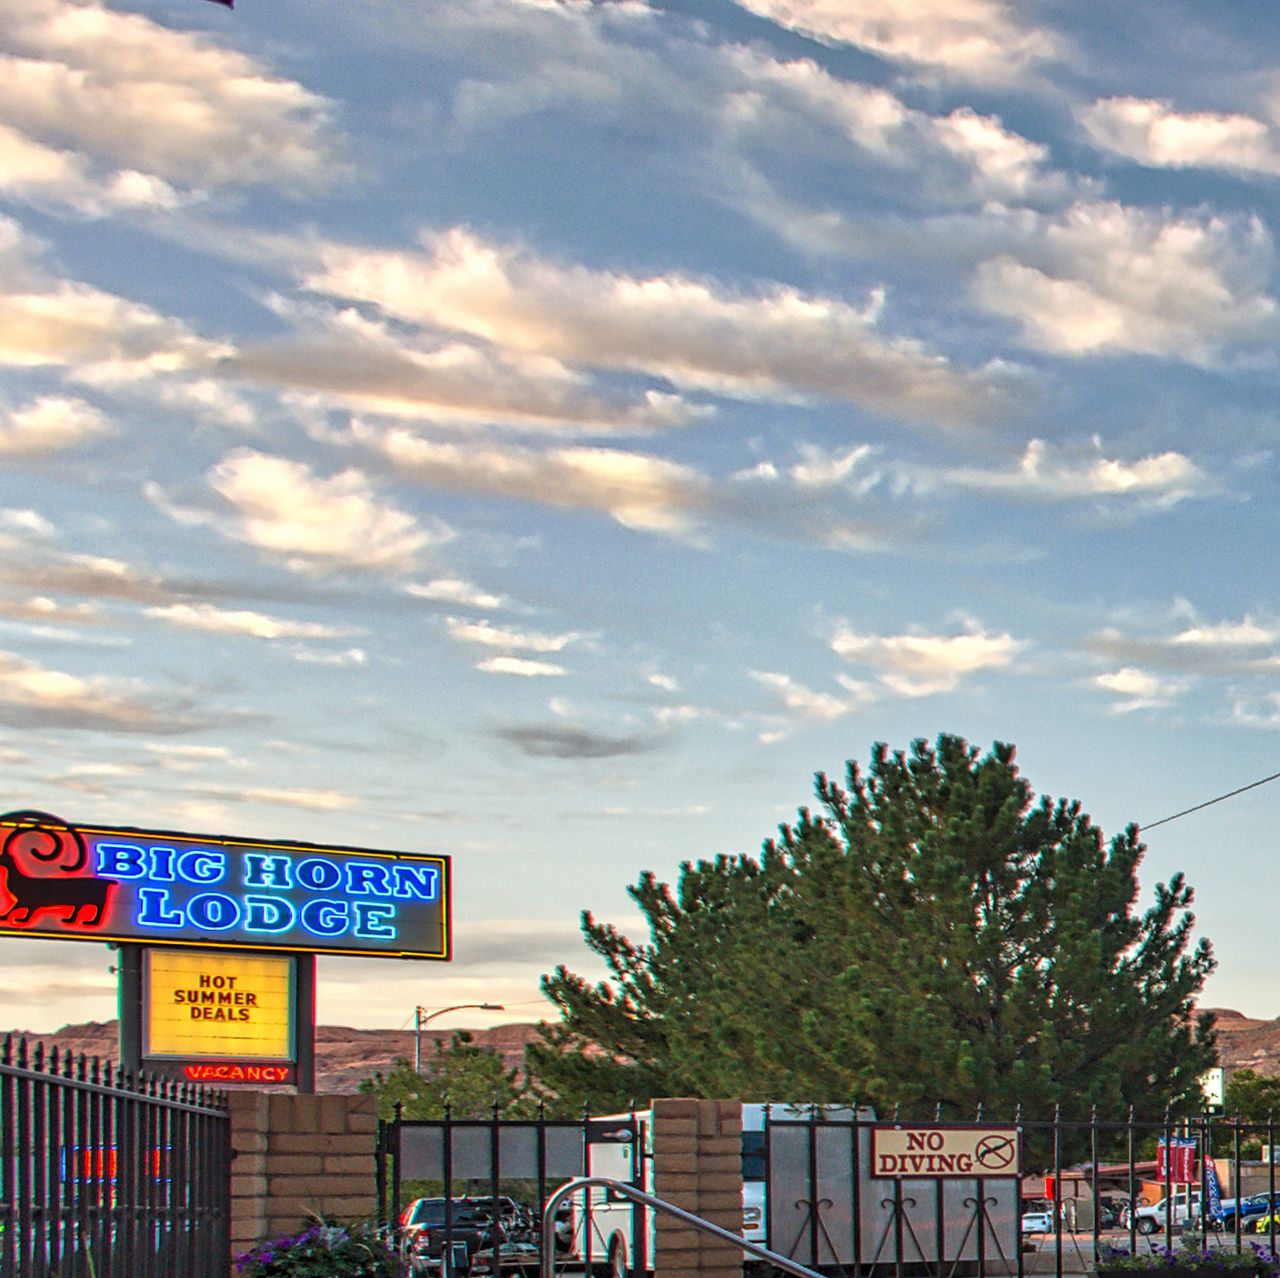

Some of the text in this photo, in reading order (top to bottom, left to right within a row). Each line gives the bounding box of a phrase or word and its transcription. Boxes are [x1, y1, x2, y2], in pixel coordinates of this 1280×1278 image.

[96, 843, 438, 900] BIG HORN
[138, 887, 396, 939] LODGE
[199, 974, 237, 990] HOT
[173, 989, 258, 1006] SUMMER
[190, 1006, 250, 1021] DEALS
[184, 1065, 289, 1081] VACANCY
[906, 1132, 944, 1151] NO
[879, 1153, 973, 1172] DIVING
